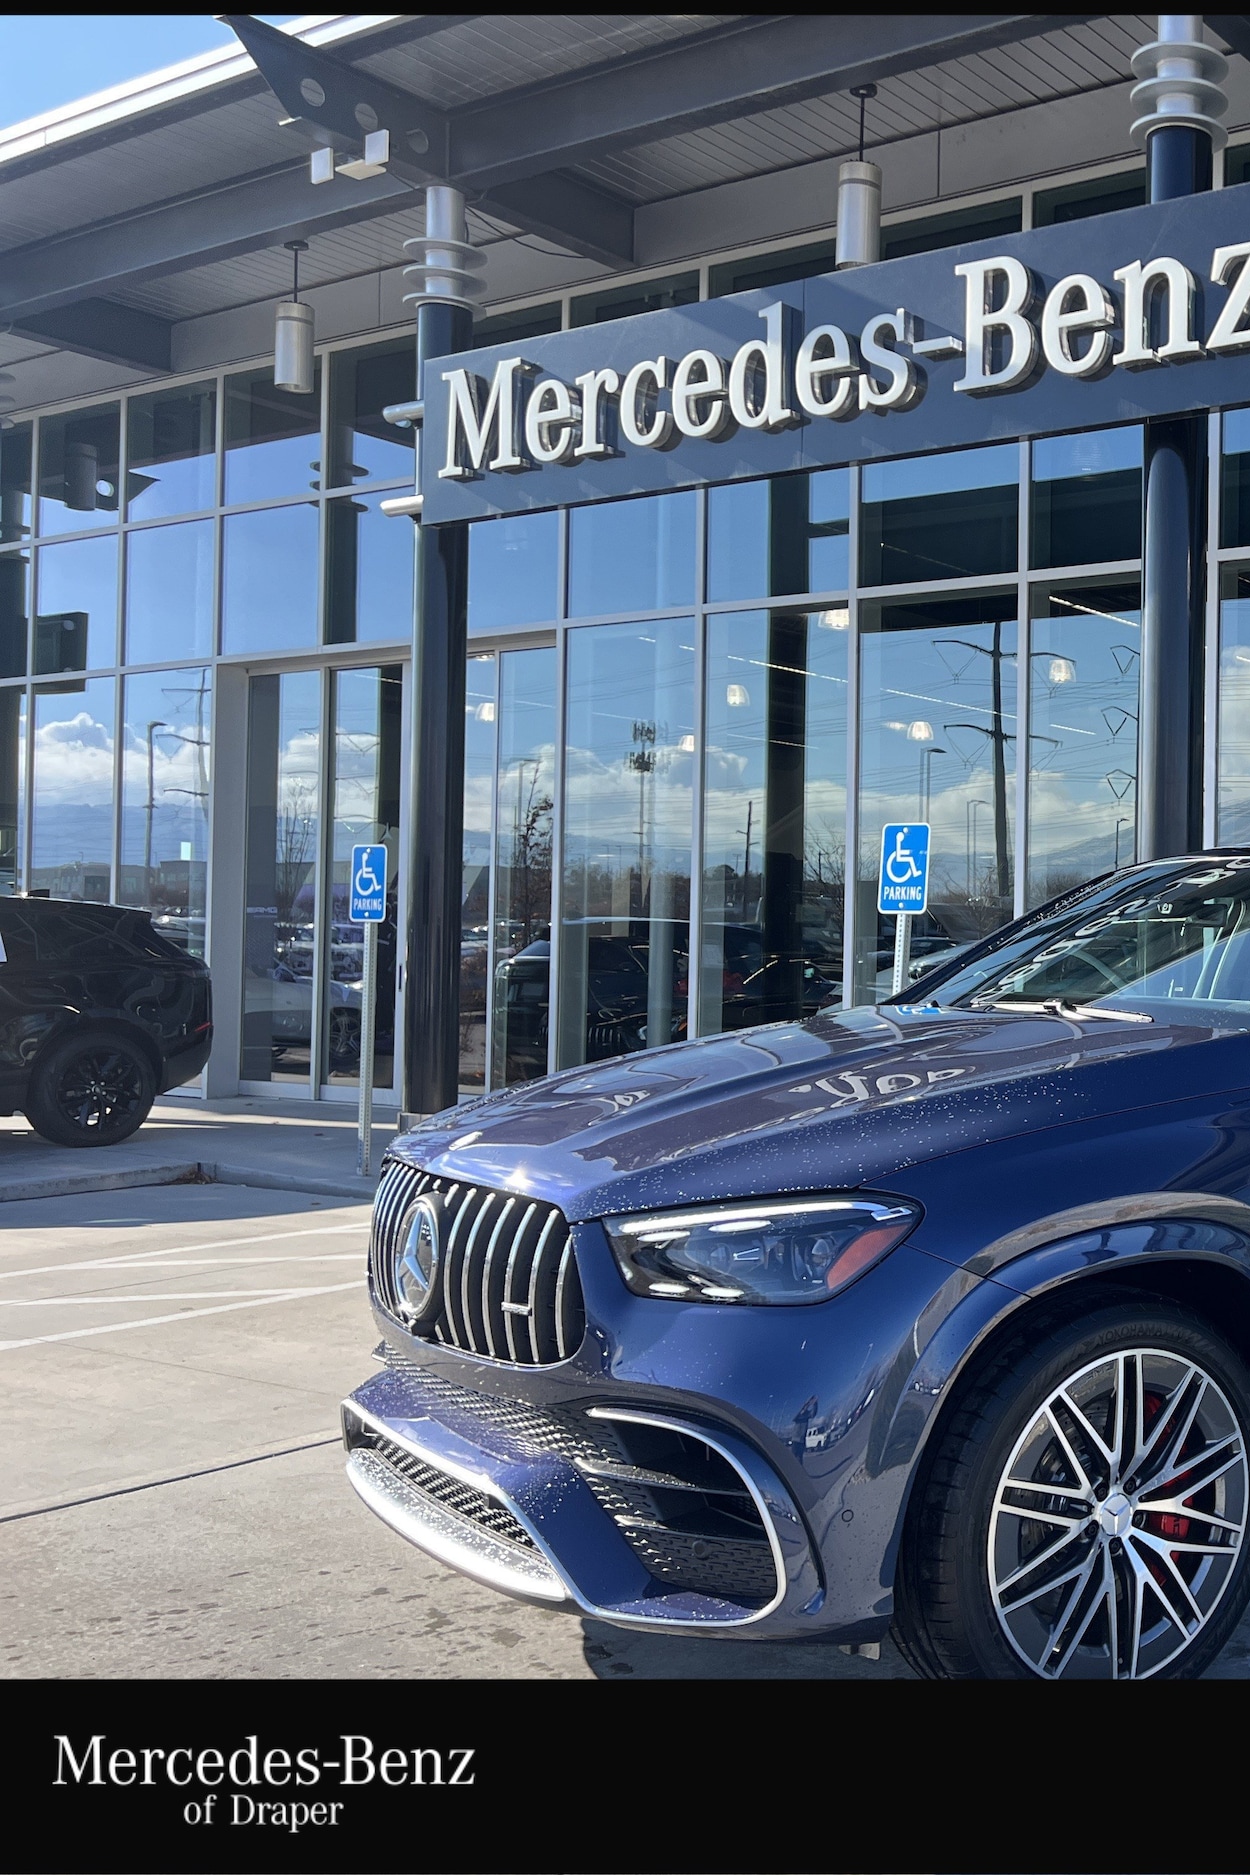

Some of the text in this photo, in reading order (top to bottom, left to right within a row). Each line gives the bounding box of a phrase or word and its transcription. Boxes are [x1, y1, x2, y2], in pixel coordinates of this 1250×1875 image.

[883, 886, 922, 901] PARKING
[353, 898, 382, 911] PARKING
[1097, 1323, 1163, 1345] YOKOHAMA
